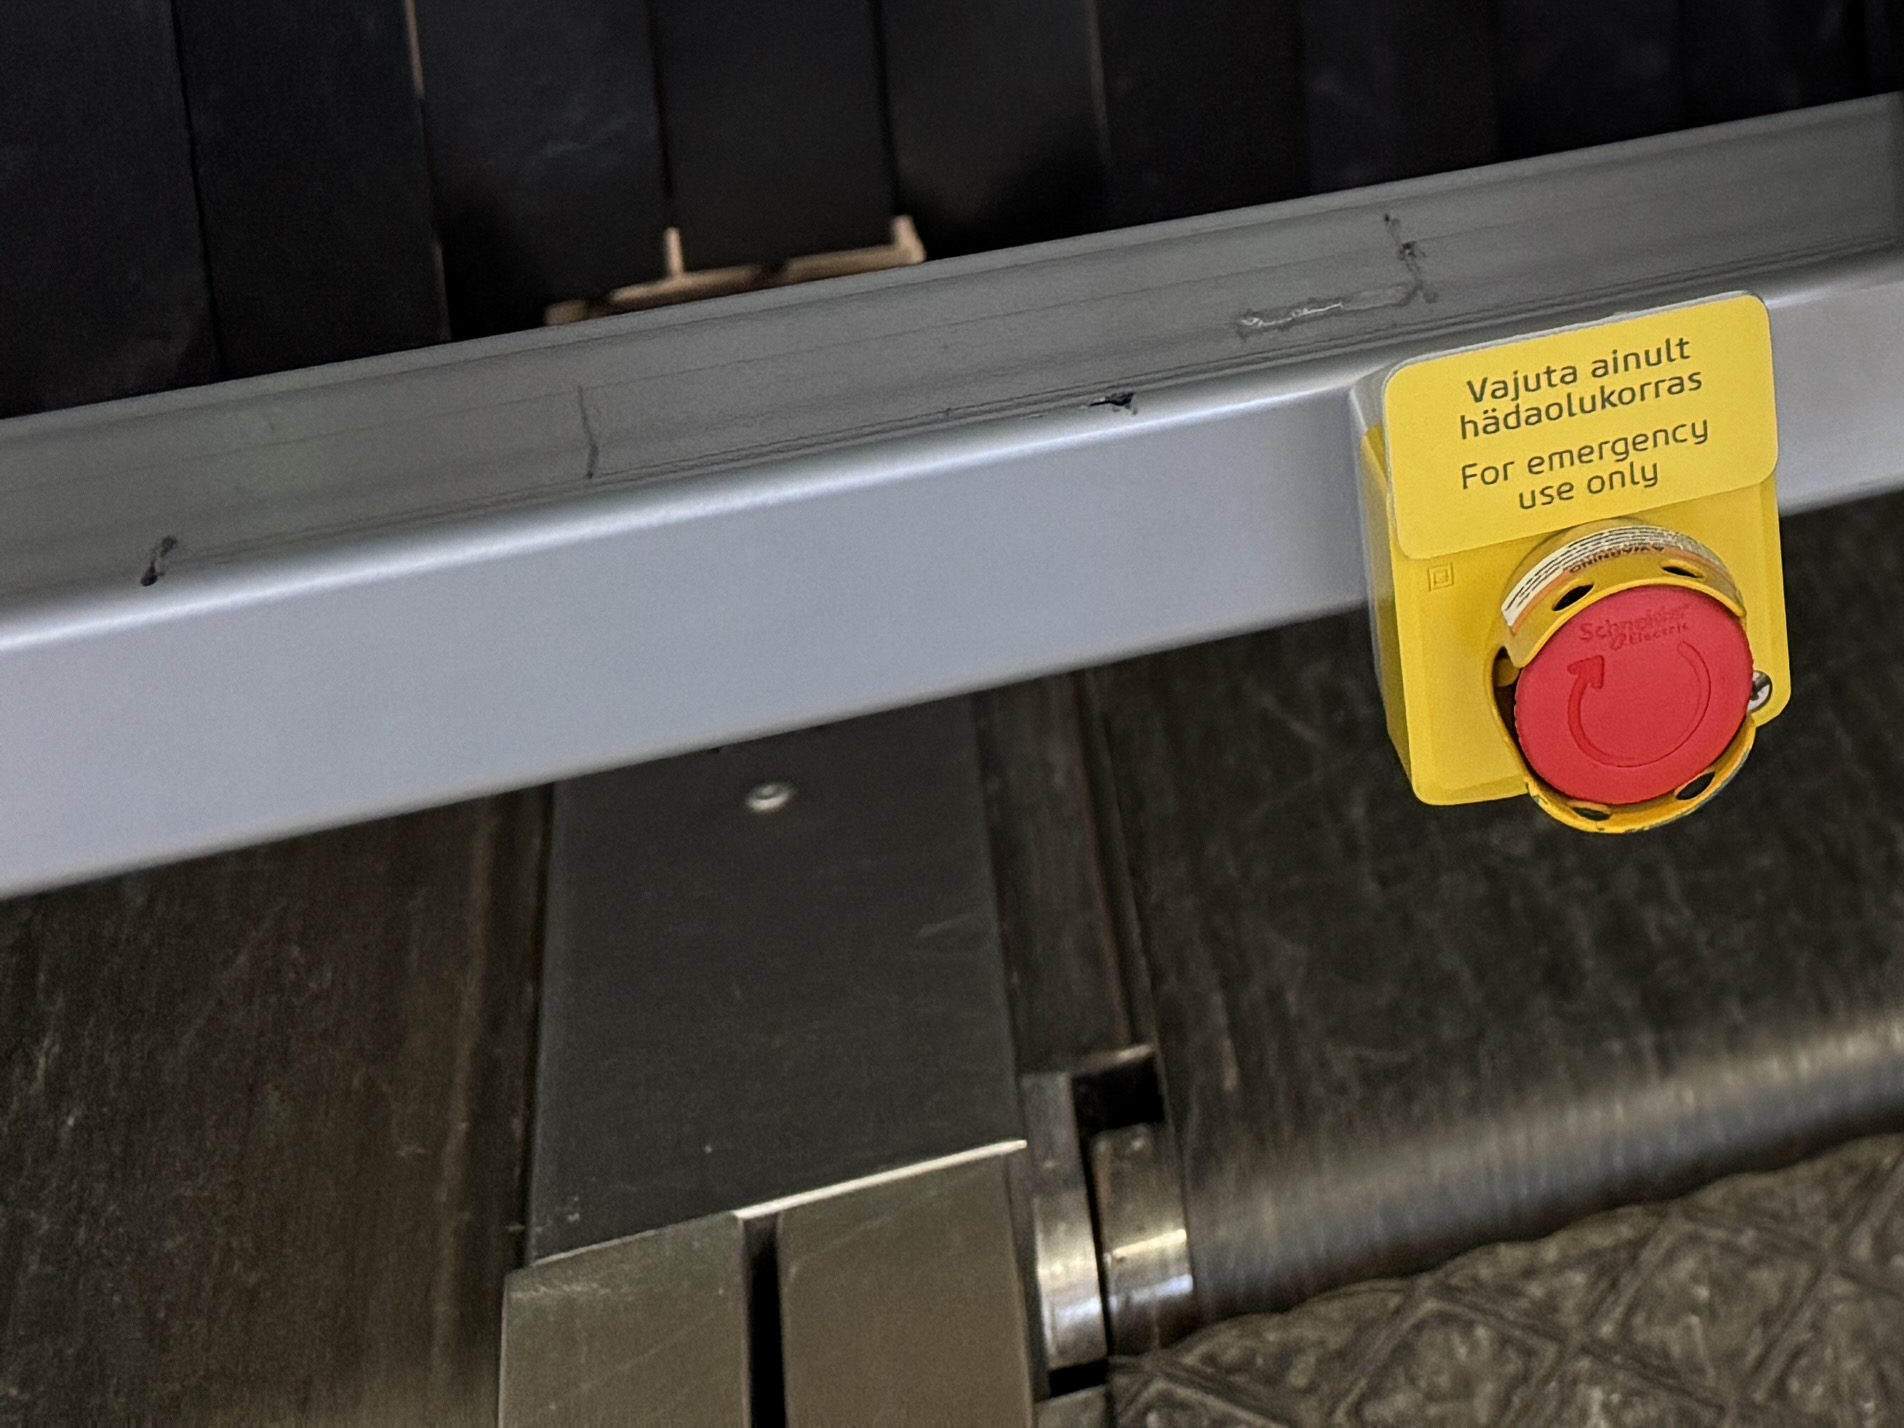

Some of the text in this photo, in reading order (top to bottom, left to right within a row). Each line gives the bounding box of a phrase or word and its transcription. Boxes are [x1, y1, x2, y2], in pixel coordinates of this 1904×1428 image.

[1466, 336, 1691, 404] Vajuta ainult
[1460, 371, 1702, 440] hädaolukorras
[1461, 418, 1709, 489] For emergency
[1519, 461, 1659, 510] use only
